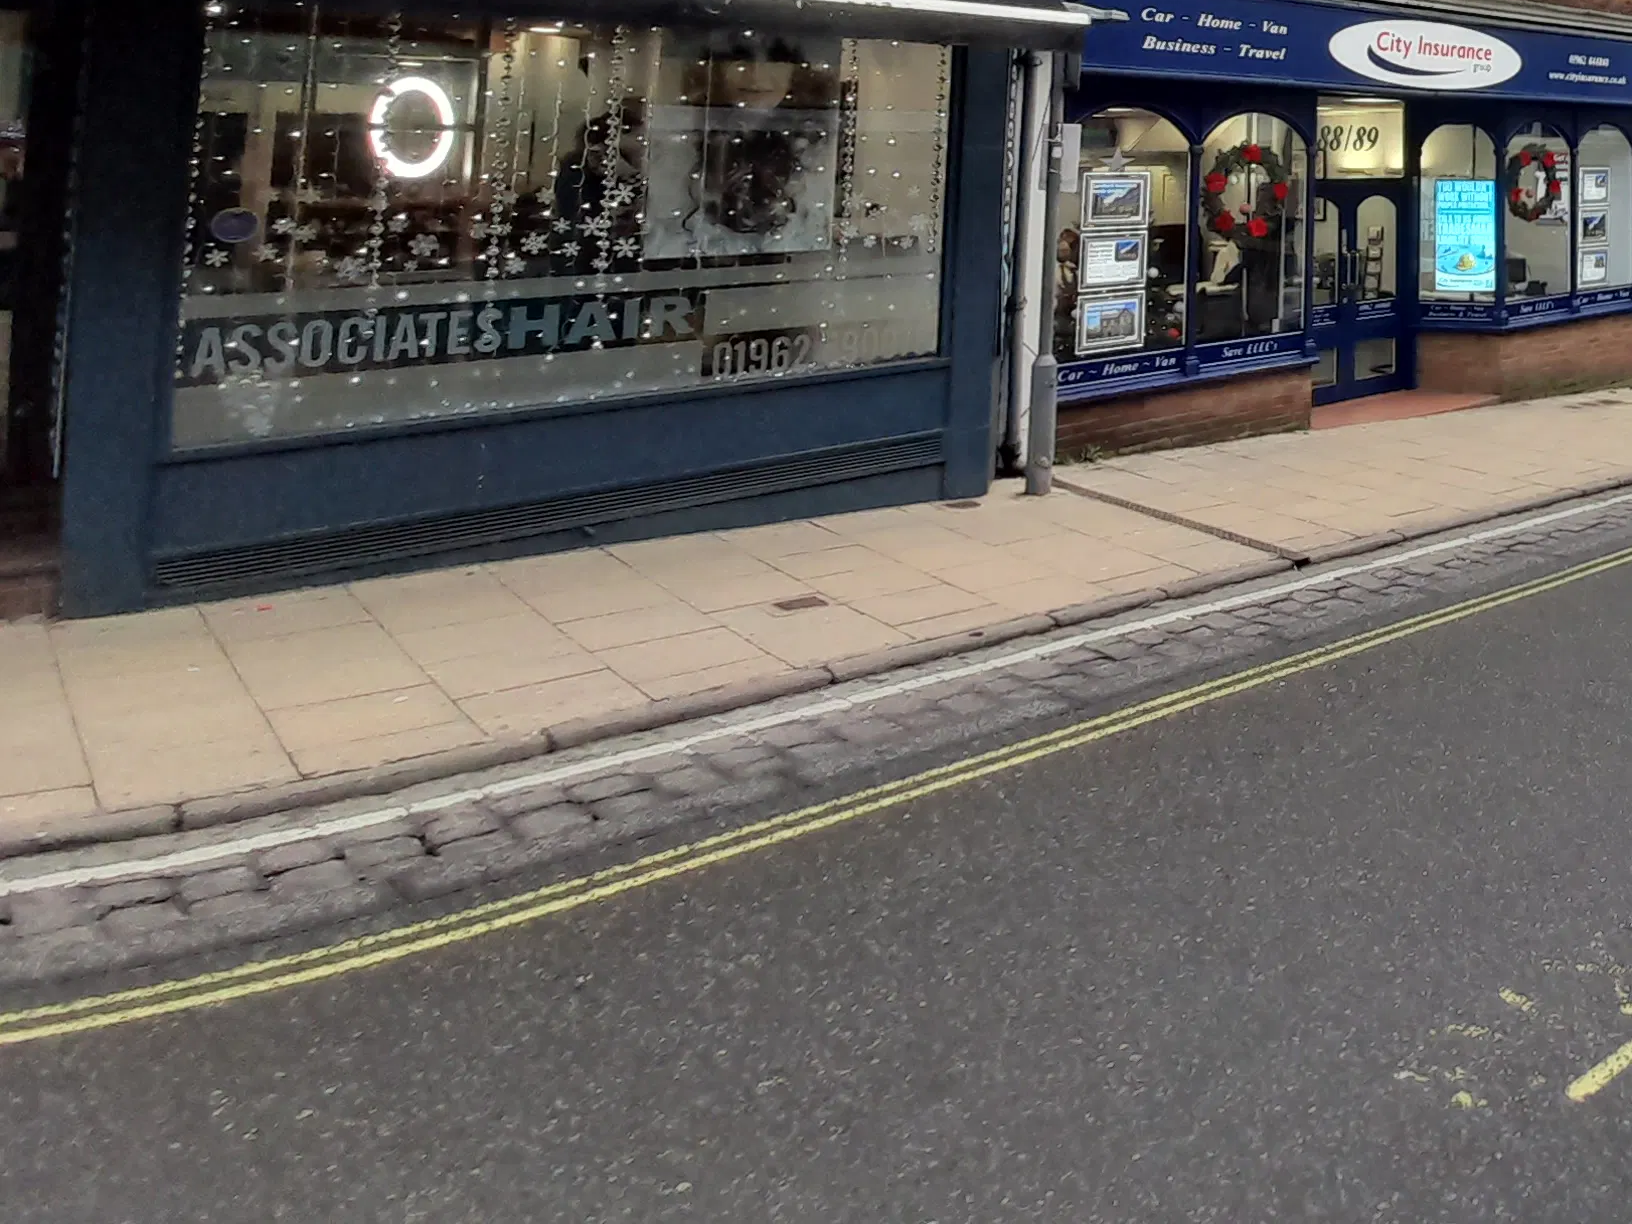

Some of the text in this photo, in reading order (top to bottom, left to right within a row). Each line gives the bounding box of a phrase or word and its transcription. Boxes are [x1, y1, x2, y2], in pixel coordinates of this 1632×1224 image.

[1140, 7, 1288, 35] Car Home Van
[1142, 35, 1286, 61] Business Travel
[1376, 31, 1492, 61] City Insurance
[1316, 124, 1379, 152] 88/89
[711, 332, 816, 381] 01962
[1221, 346, 1244, 358] Save
[1057, 356, 1177, 383] Car Home Van
